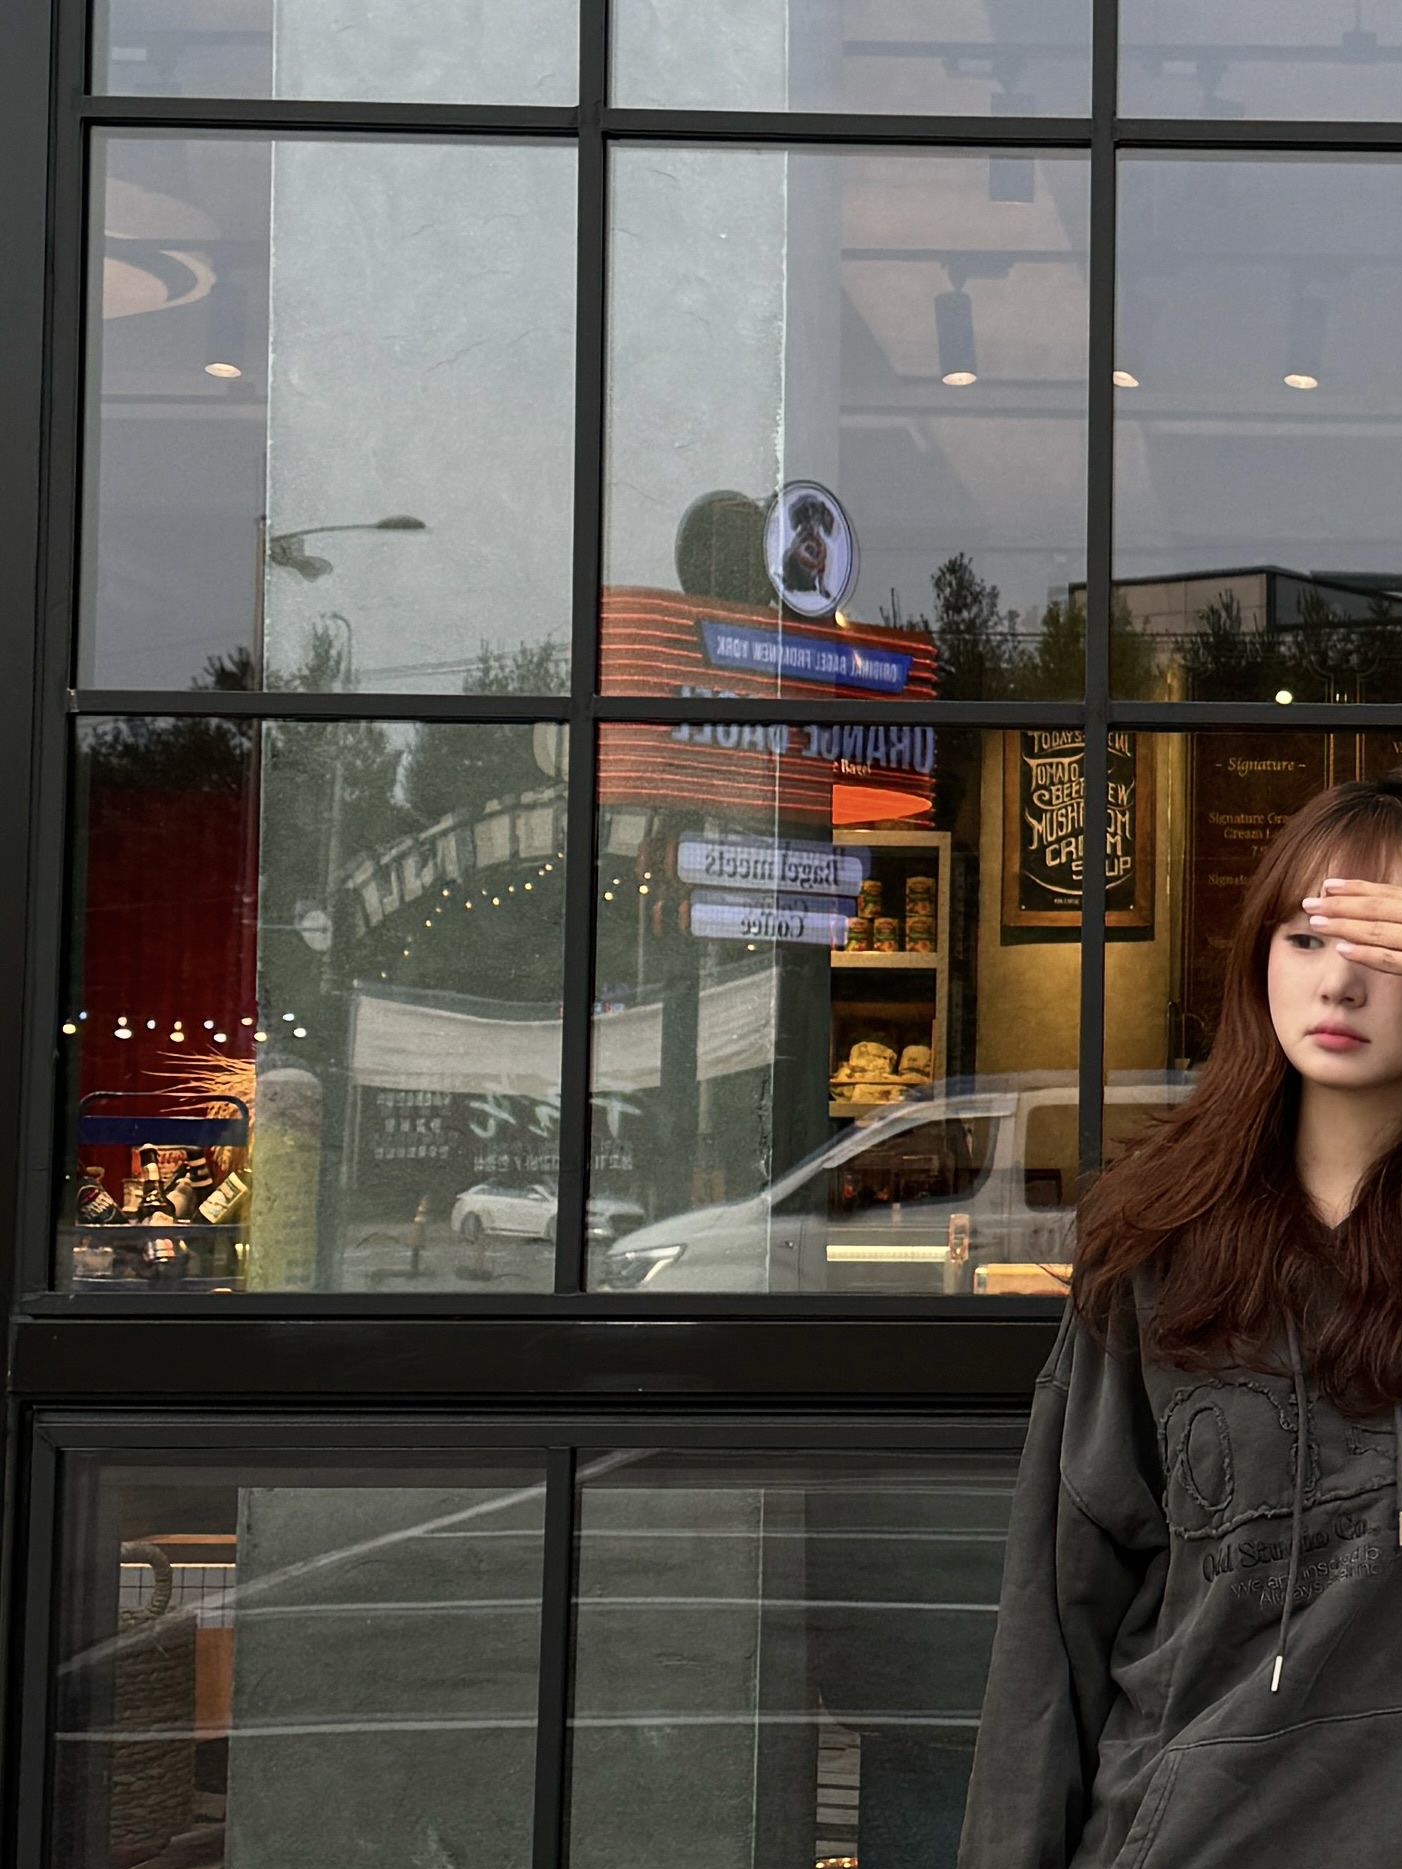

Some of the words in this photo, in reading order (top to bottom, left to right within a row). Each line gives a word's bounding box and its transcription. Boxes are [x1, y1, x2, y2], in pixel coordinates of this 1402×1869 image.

[1023, 753, 1084, 793] TOMATO
[1227, 757, 1295, 777] Signature
[1208, 812, 1265, 826] Signature
[1223, 827, 1263, 840] Cream
[1071, 856, 1132, 881] SUP
[1238, 1527, 1330, 1569] Stuio
